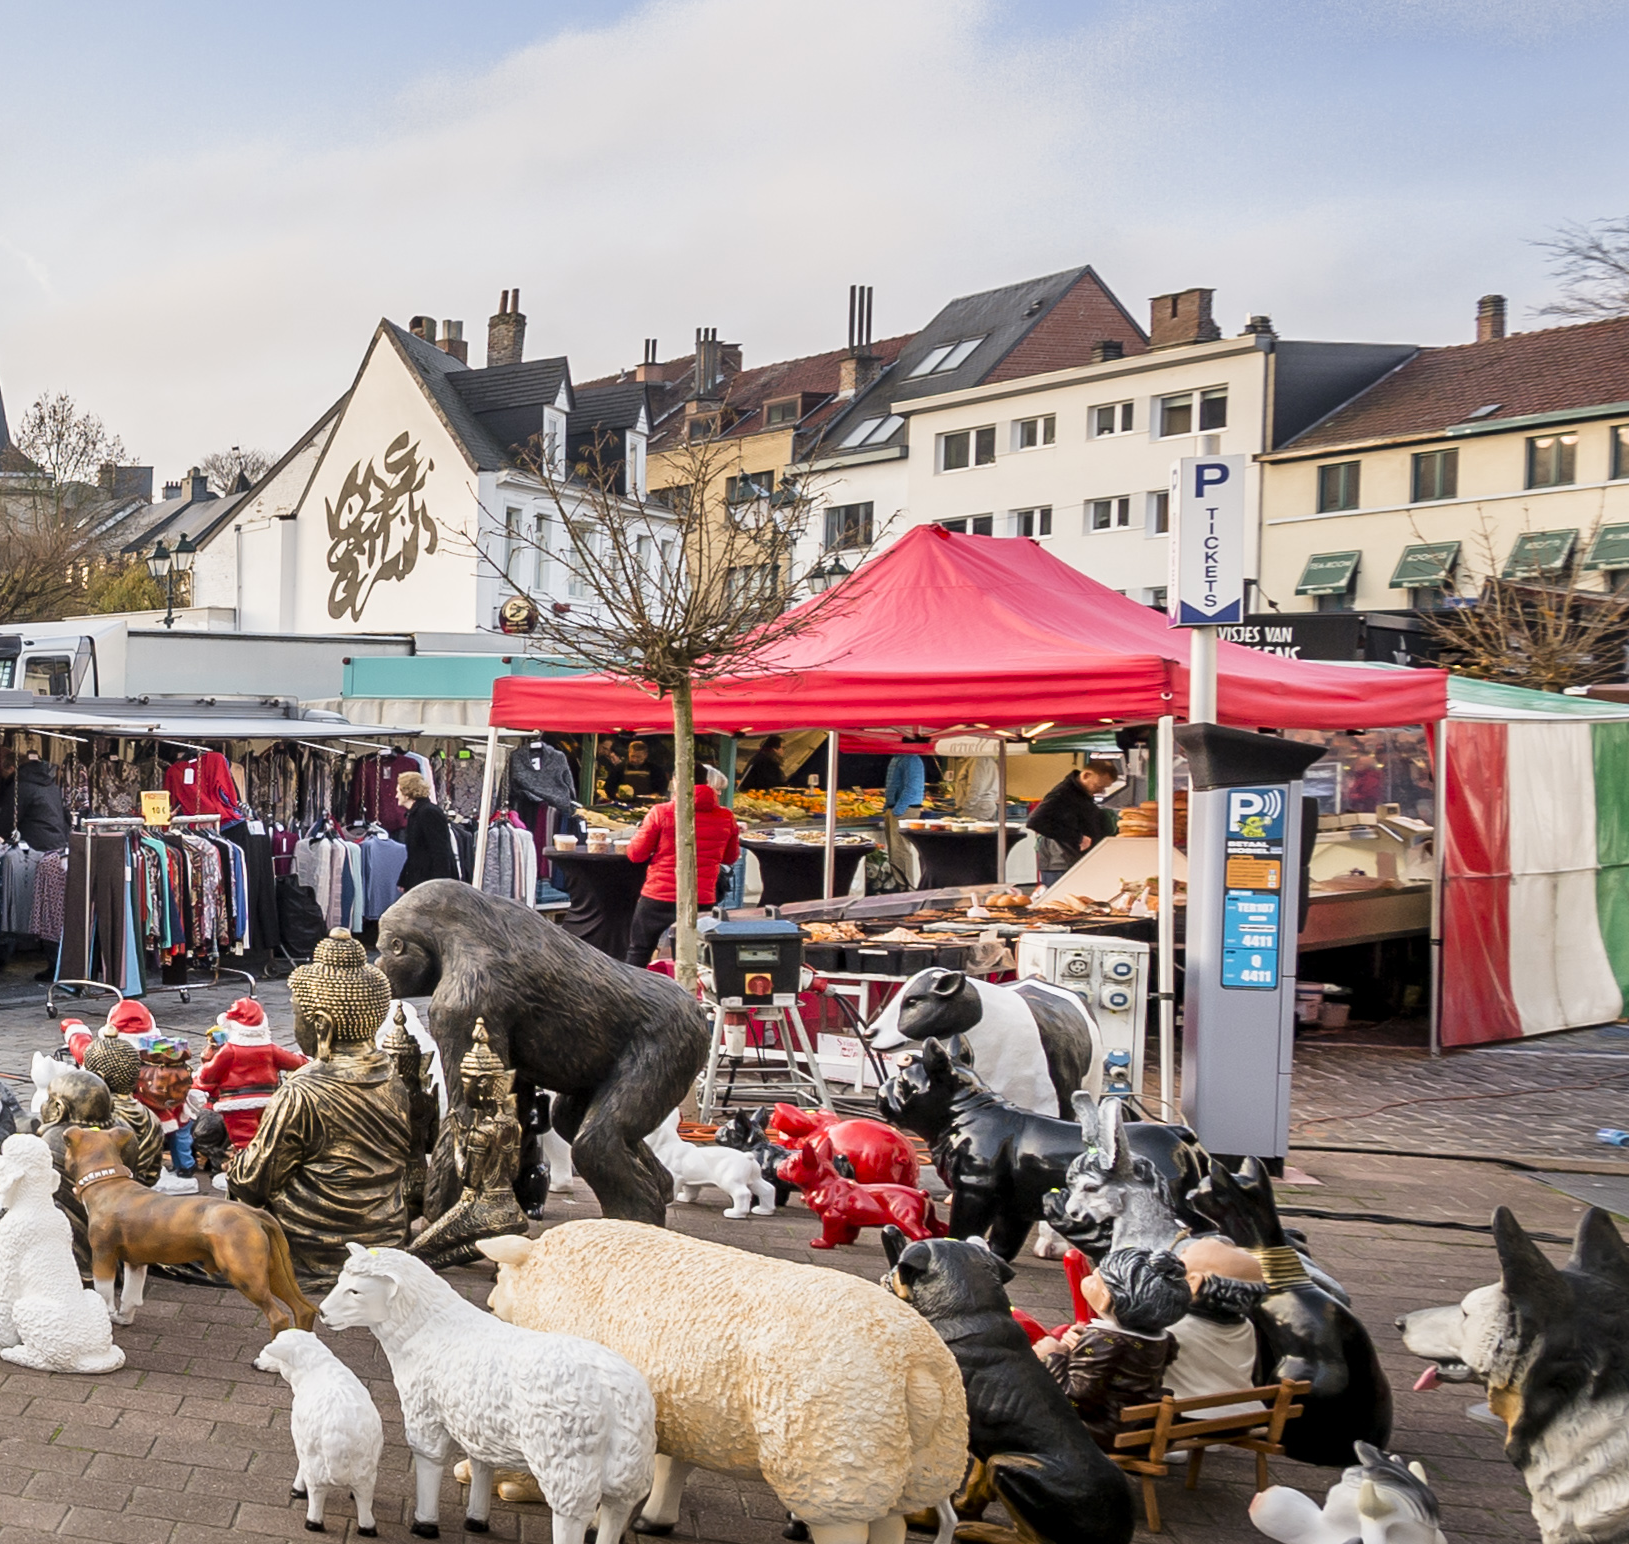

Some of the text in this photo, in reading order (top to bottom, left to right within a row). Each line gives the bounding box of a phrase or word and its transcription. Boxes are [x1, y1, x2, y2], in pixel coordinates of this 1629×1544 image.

[1195, 463, 1230, 498] P
[1203, 507, 1219, 608] TICKETS
[1217, 626, 1293, 643] VISJES VAN
[1229, 792, 1264, 832] P
[1241, 934, 1273, 947] 4411
[1240, 969, 1272, 982] 4411
